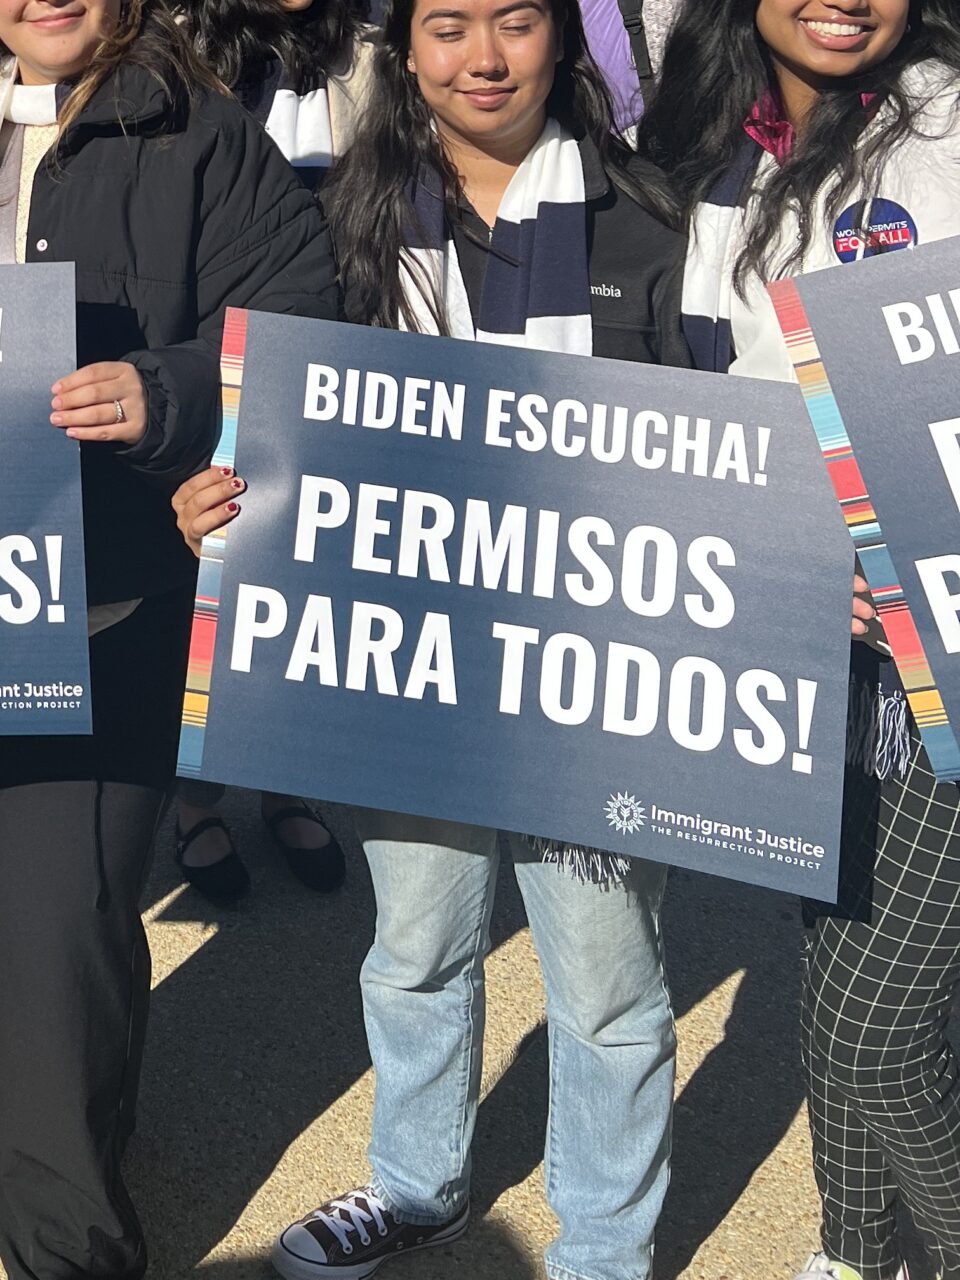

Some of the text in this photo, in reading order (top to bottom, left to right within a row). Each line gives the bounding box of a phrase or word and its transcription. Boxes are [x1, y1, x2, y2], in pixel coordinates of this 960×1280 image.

[879, 230, 908, 244] ALL
[303, 363, 772, 487] BIDEN ESCUCHA!
[293, 474, 737, 629] PERMISOS
[24, 682, 84, 697] Justice
[229, 583, 818, 775] PARA TODOS!
[36, 701, 81, 709] PROJECT
[651, 804, 825, 858] Immigrant Justice
[651, 824, 822, 870] THE RESURRECTION PROJECT
